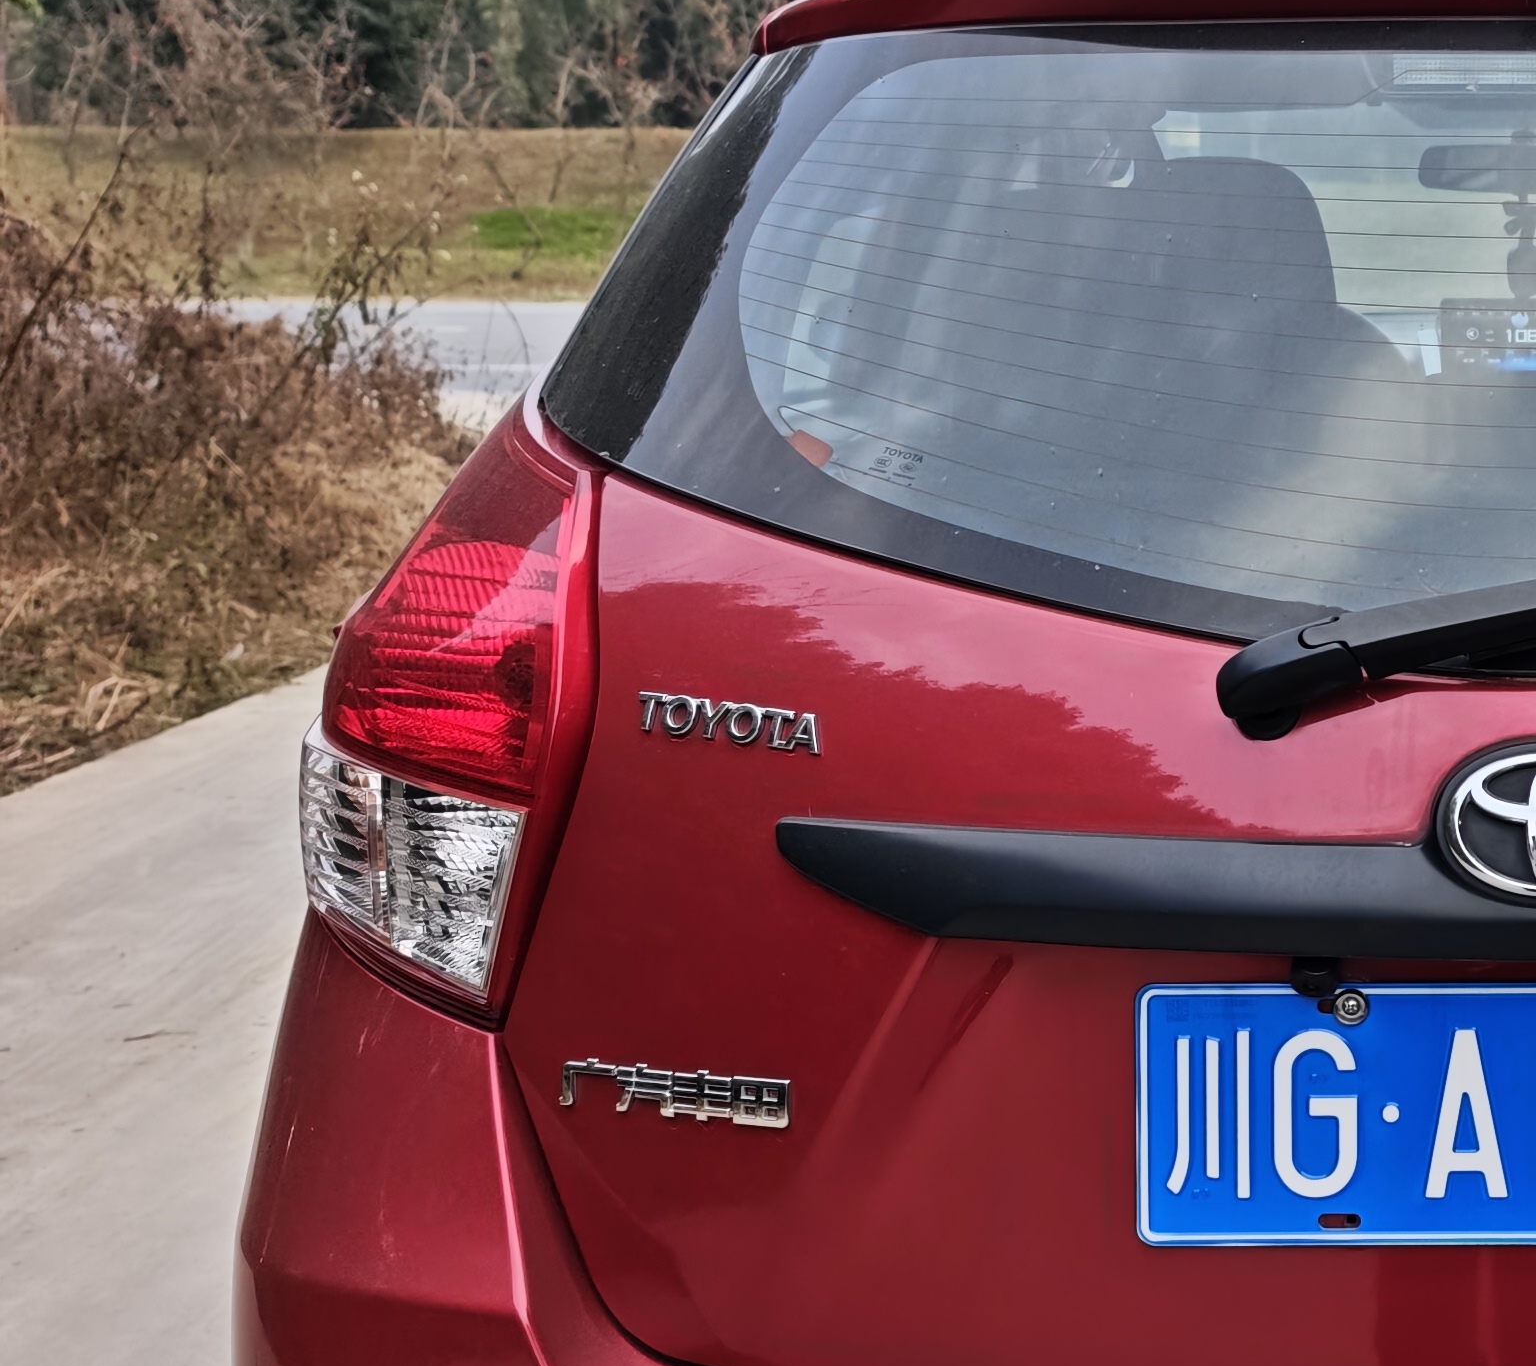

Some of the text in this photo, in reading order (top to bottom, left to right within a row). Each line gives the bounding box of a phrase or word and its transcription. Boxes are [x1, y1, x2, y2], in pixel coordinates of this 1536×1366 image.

[883, 447, 924, 464] TOYOTA
[638, 691, 821, 755] TOYOTA
[558, 1057, 792, 1129] 广汽丰田
